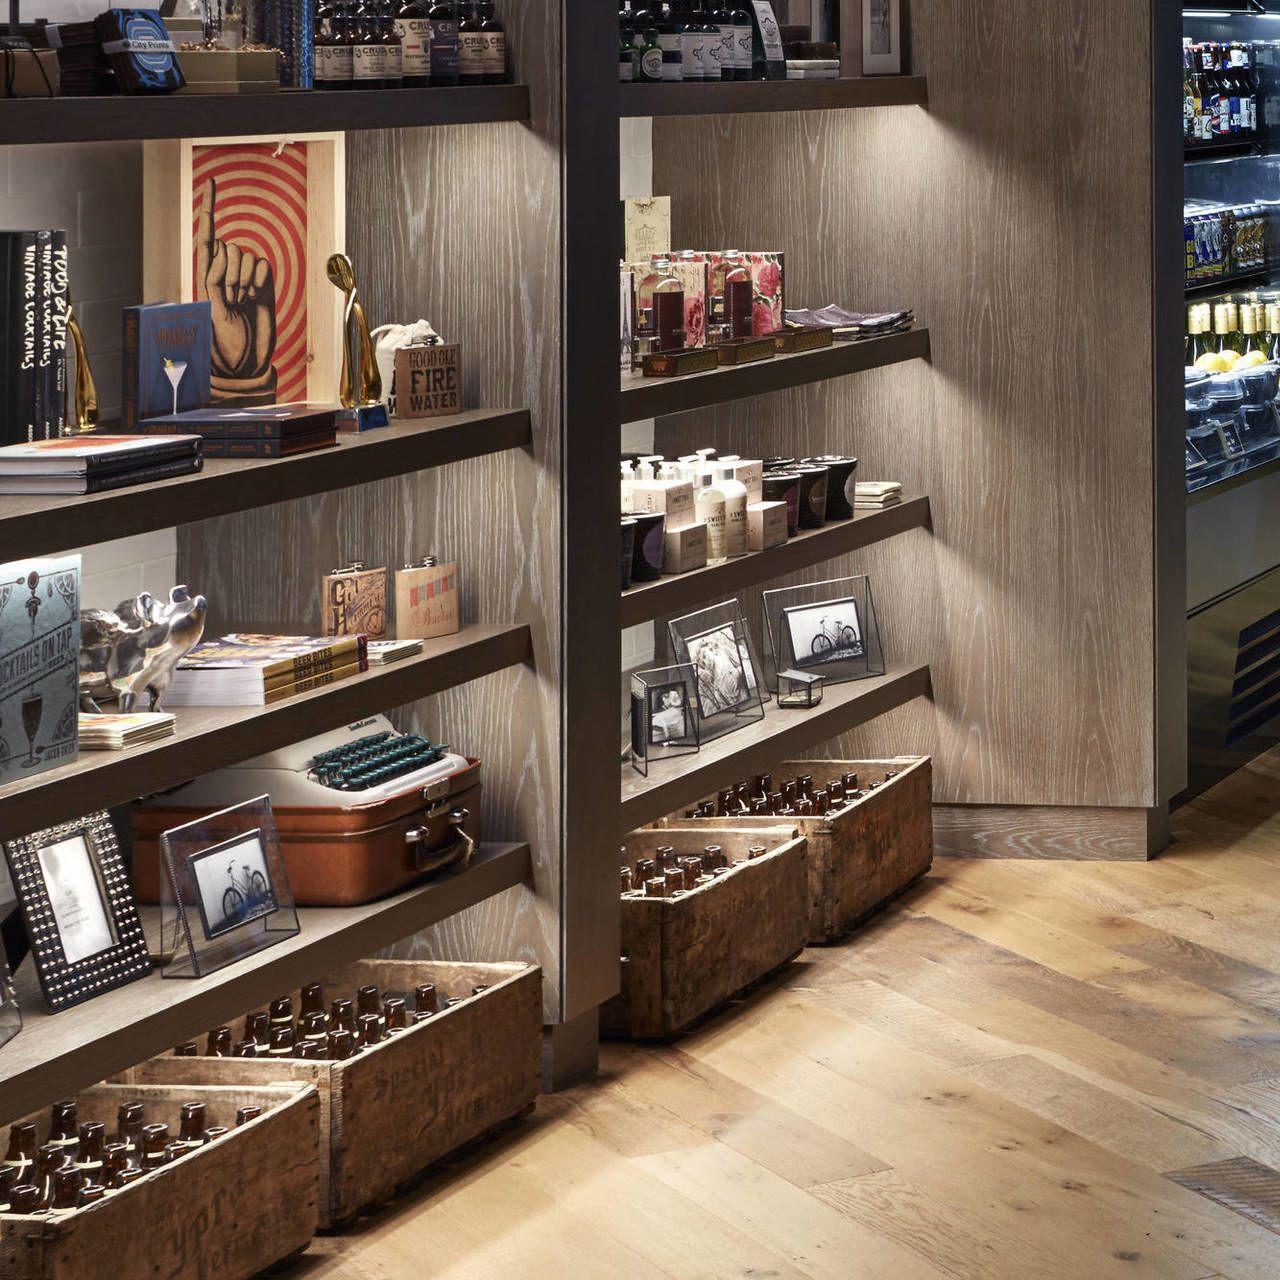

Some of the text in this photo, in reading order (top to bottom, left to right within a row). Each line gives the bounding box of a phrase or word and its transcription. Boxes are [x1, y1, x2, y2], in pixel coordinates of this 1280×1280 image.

[21, 245, 36, 370] VINTAGE COCKTAILS
[409, 350, 437, 369] GOOD
[411, 367, 457, 394] FIRE
[410, 392, 457, 411] WATER
[42, 635, 54, 661] ON
[57, 625, 72, 655] TAP
[293, 647, 333, 668] BEER BITES
